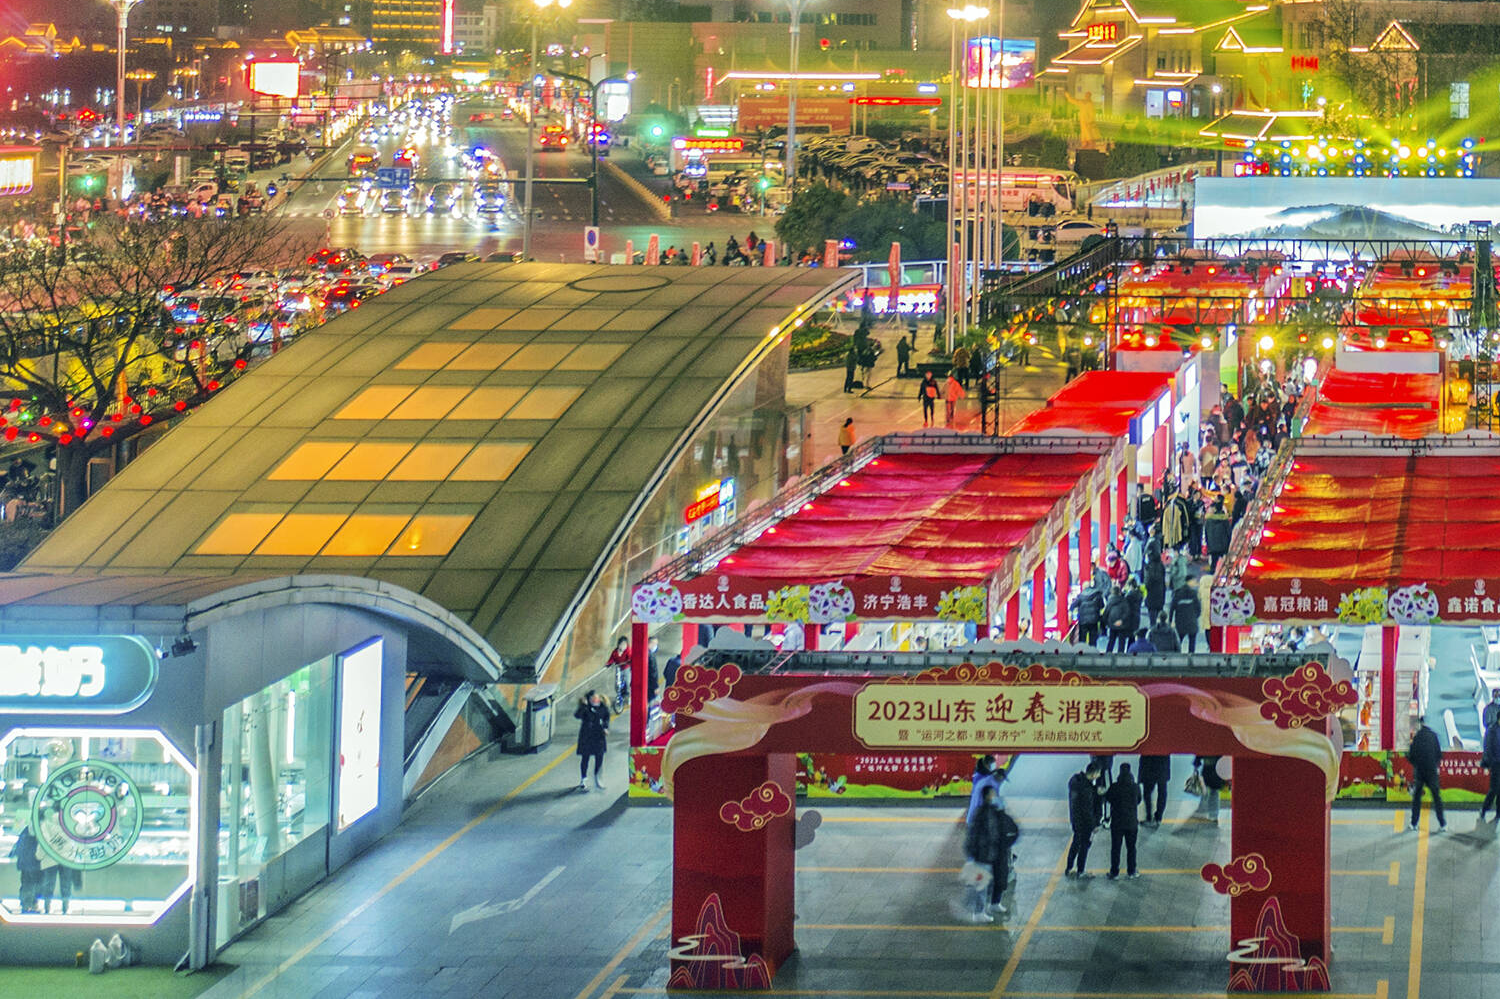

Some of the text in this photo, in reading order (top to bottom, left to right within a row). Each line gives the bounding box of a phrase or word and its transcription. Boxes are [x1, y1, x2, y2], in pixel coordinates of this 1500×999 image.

[684, 594, 764, 610] 香达人食品
[863, 594, 928, 610] 济宁浩丰
[1263, 596, 1329, 613] 嘉冠粮油
